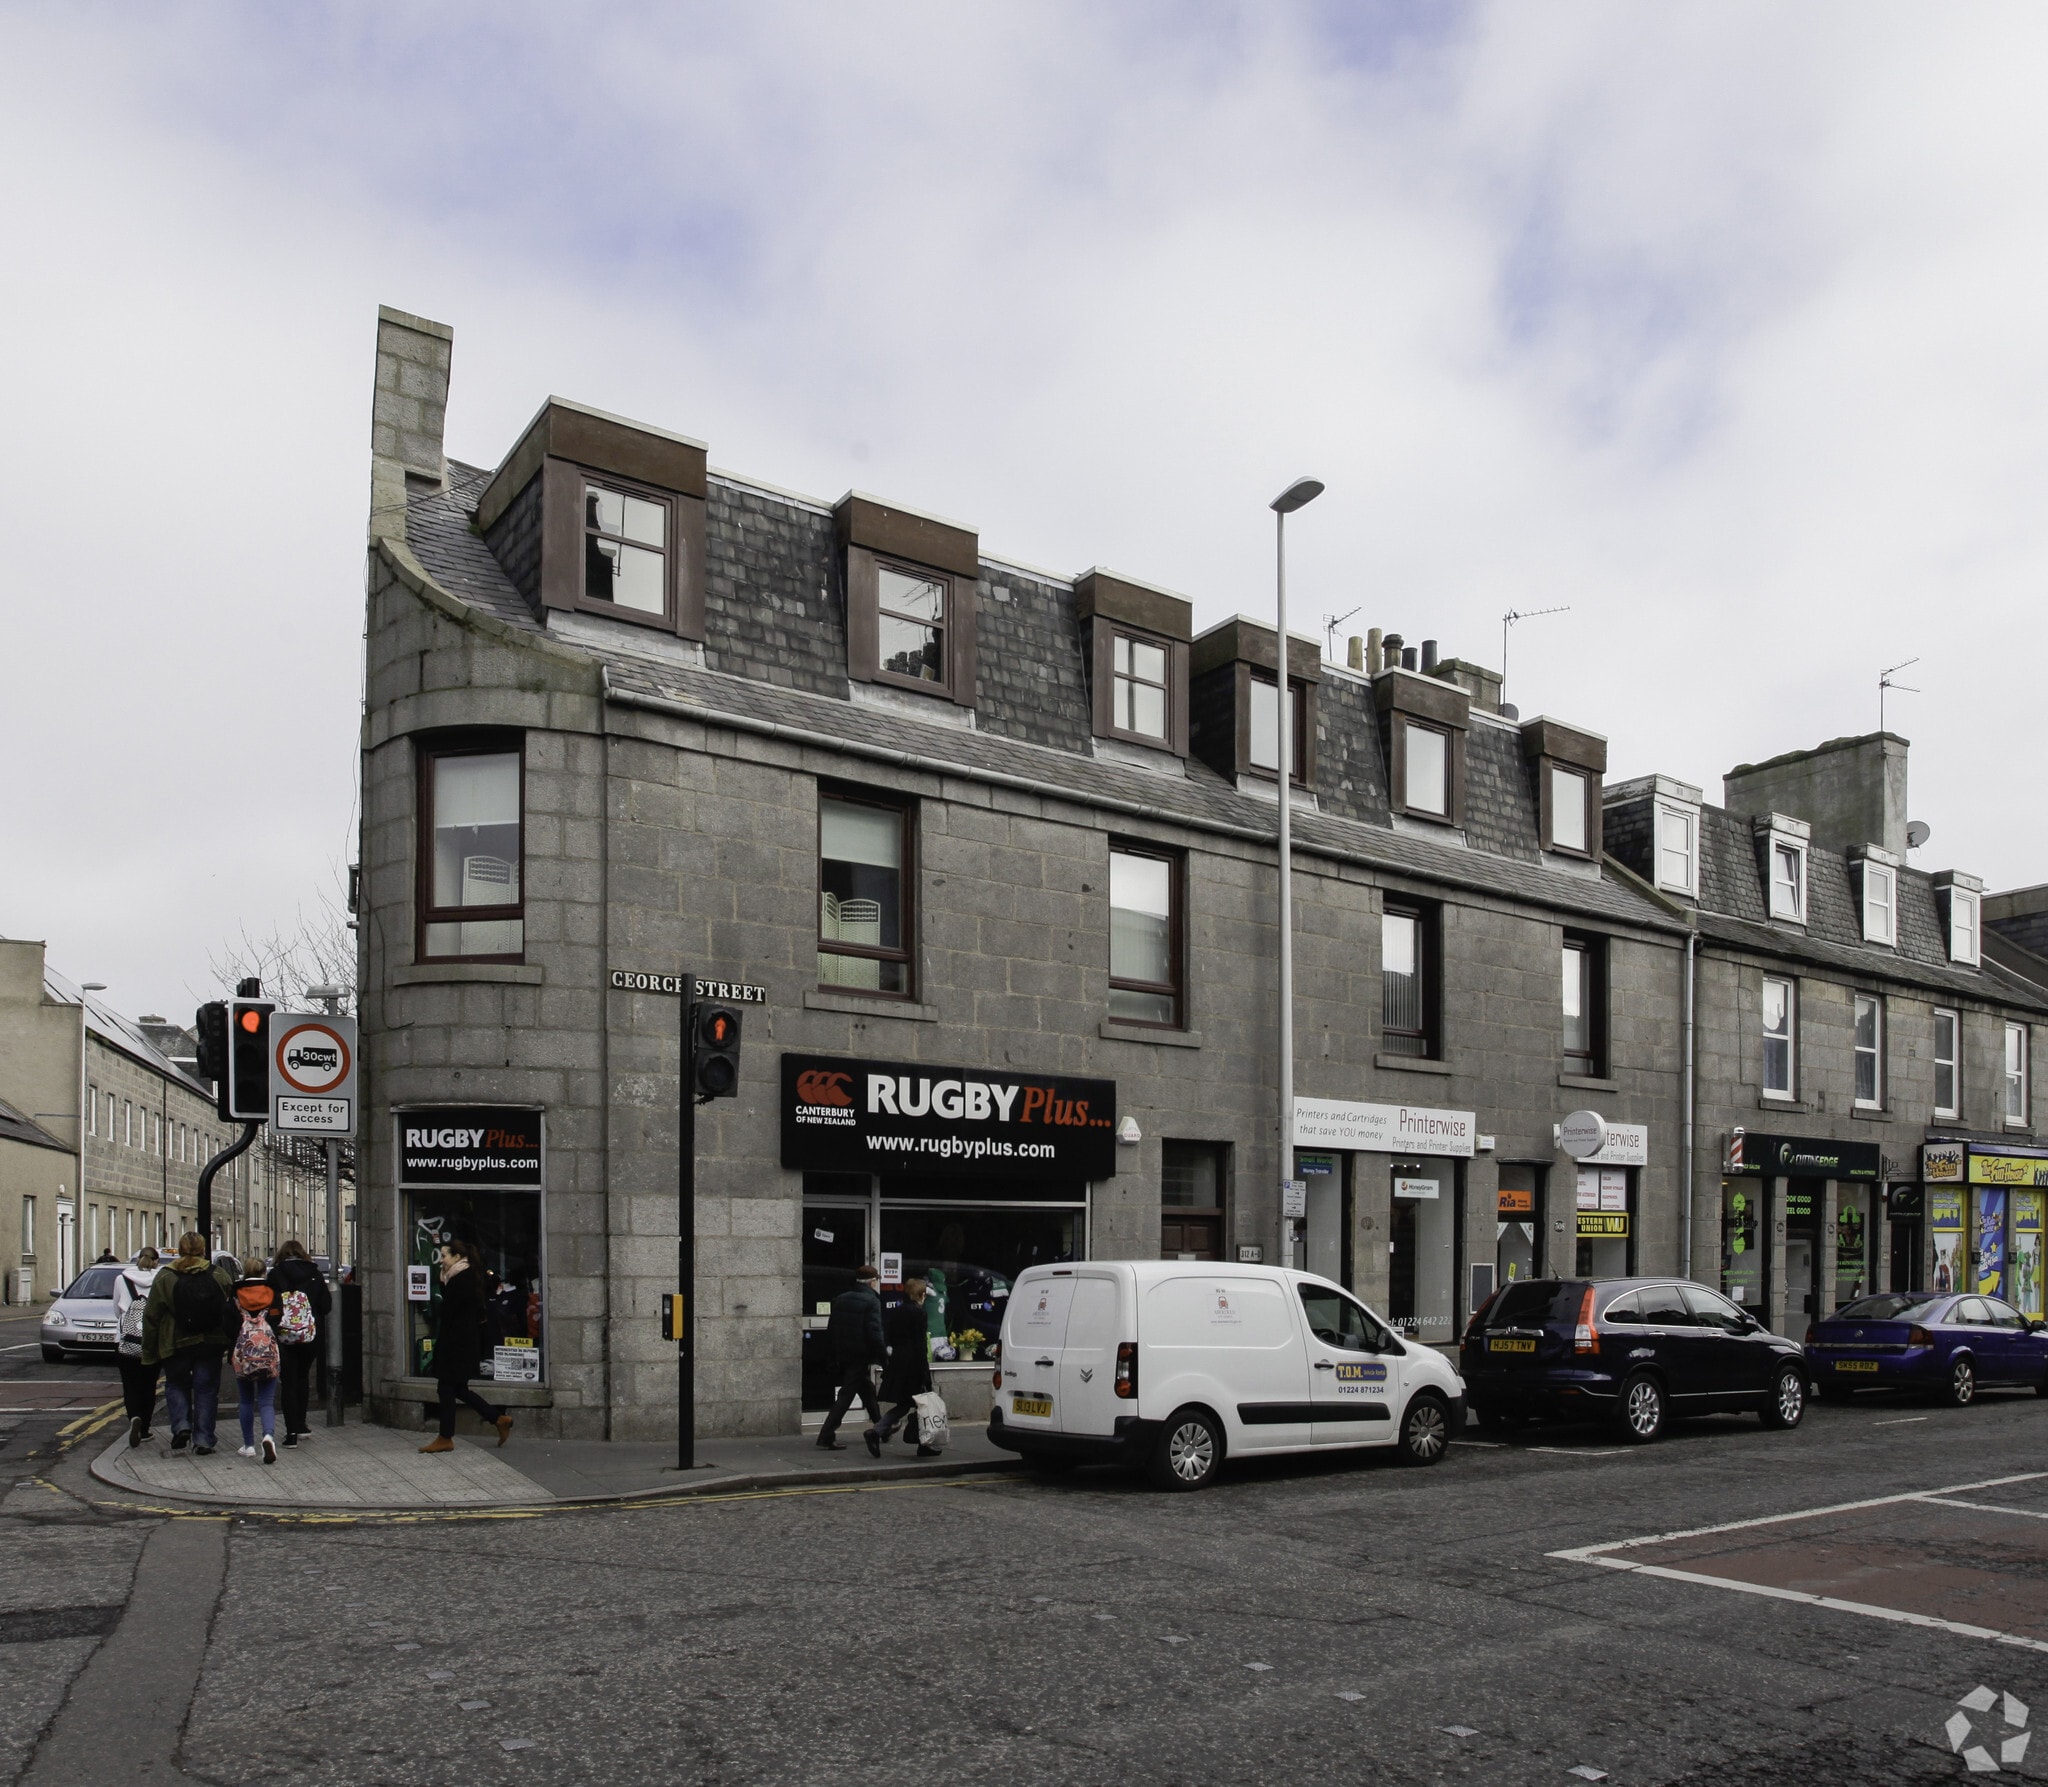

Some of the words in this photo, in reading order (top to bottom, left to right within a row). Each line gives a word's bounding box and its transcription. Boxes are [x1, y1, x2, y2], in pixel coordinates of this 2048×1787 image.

[696, 980, 765, 1002] STREET
[303, 1051, 337, 1062] 30cwt
[282, 1102, 322, 1113] Except
[328, 1103, 345, 1113] for
[867, 1074, 1019, 1122] RUGBY
[1019, 1086, 1112, 1128] Plus...
[795, 1105, 855, 1118] CANTERBURY
[1296, 1108, 1329, 1120] Printers
[1330, 1112, 1346, 1121] and
[1346, 1113, 1388, 1126] Cartridges
[293, 1115, 334, 1124] access
[807, 1116, 823, 1124] NEW
[824, 1117, 857, 1126] ZEALAND
[1399, 1108, 1466, 1137] Printerwise
[1299, 1125, 1317, 1134] that
[1319, 1128, 1337, 1136] save
[1339, 1127, 1356, 1137] YOU
[1358, 1132, 1383, 1140] money
[1563, 1126, 1598, 1136] Printerwise
[406, 1129, 485, 1148] RUGBY
[485, 1129, 540, 1148] Plus...
[1393, 1136, 1415, 1149] Printers
[1417, 1140, 1428, 1150] and
[1429, 1140, 1448, 1151] Printer
[1449, 1143, 1472, 1155] Supplies
[1606, 1129, 1640, 1148] terwise
[866, 1135, 1056, 1159] www.rugbyplus.com
[406, 1156, 538, 1171] www.rugbyplus.com
[1499, 1193, 1516, 1208] Ria
[1796, 1207, 1811, 1215] GOOD
[1577, 1217, 1603, 1225] ESTERN
[1581, 1224, 1603, 1232] UNION
[1606, 1217, 1625, 1232] WU
[886, 1301, 897, 1309] BT
[937, 1298, 946, 1314] 3
[1493, 1341, 1515, 1350] HJ57
[1516, 1341, 1532, 1350] TNV
[1337, 1365, 1363, 1378] T.O.M.
[1338, 1386, 1359, 1394] 01224
[1360, 1386, 1385, 1394] 871234
[1015, 1400, 1031, 1412] SL13
[1032, 1402, 1047, 1414] LVJ
